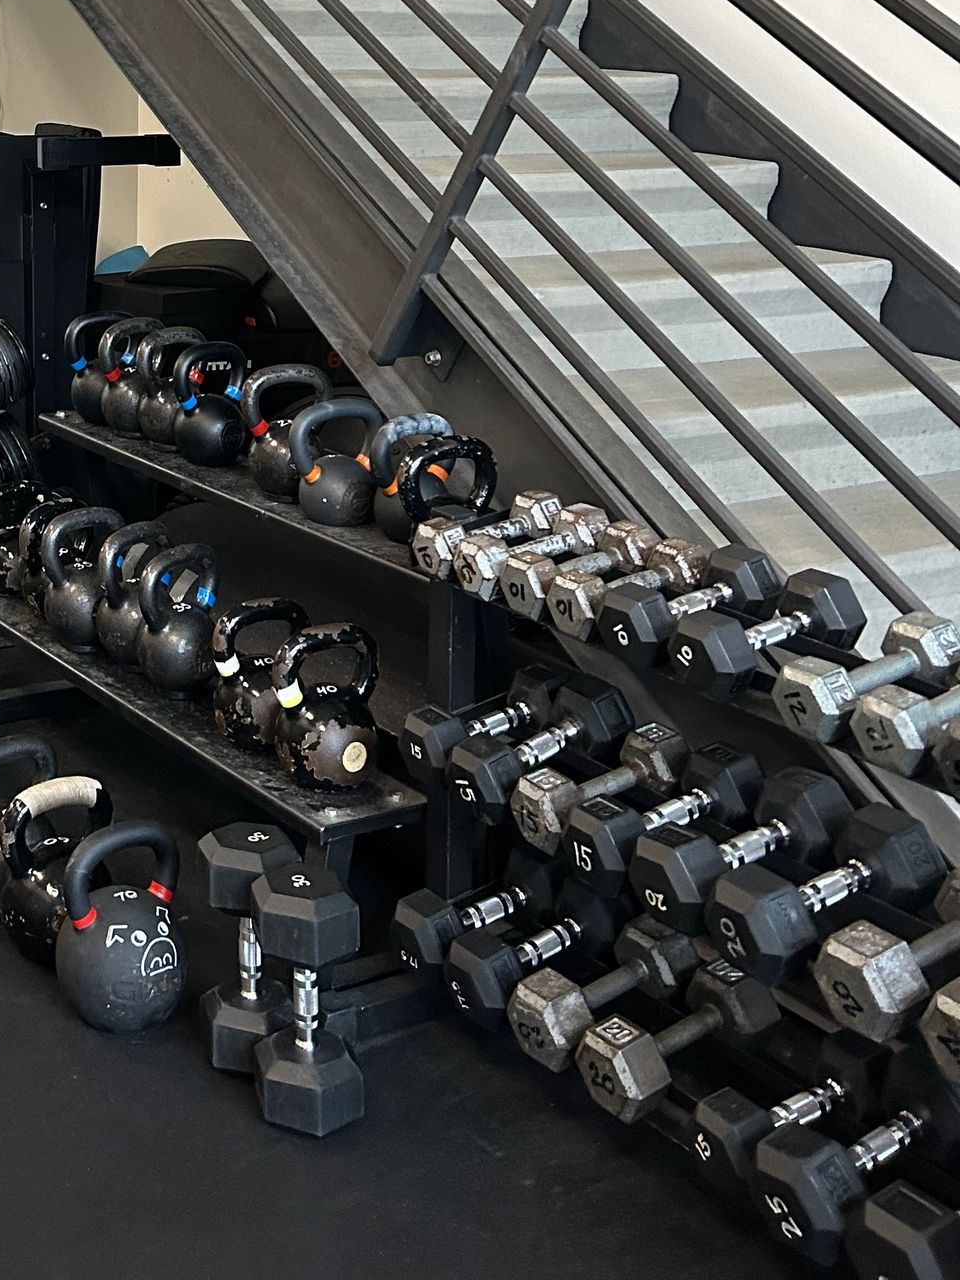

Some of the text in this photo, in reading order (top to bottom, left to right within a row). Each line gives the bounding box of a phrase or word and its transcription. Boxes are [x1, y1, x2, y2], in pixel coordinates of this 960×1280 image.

[612, 623, 630, 646] 10
[253, 657, 275, 667] 40
[676, 645, 693, 667] 10
[316, 685, 338, 697] 40
[783, 691, 808, 726] 12
[409, 742, 422, 760] 15
[455, 779, 477, 803] 15
[573, 841, 593, 872] 15
[113, 889, 138, 902] 70
[695, 1133, 712, 1161] 15
[765, 1194, 803, 1240] 25
